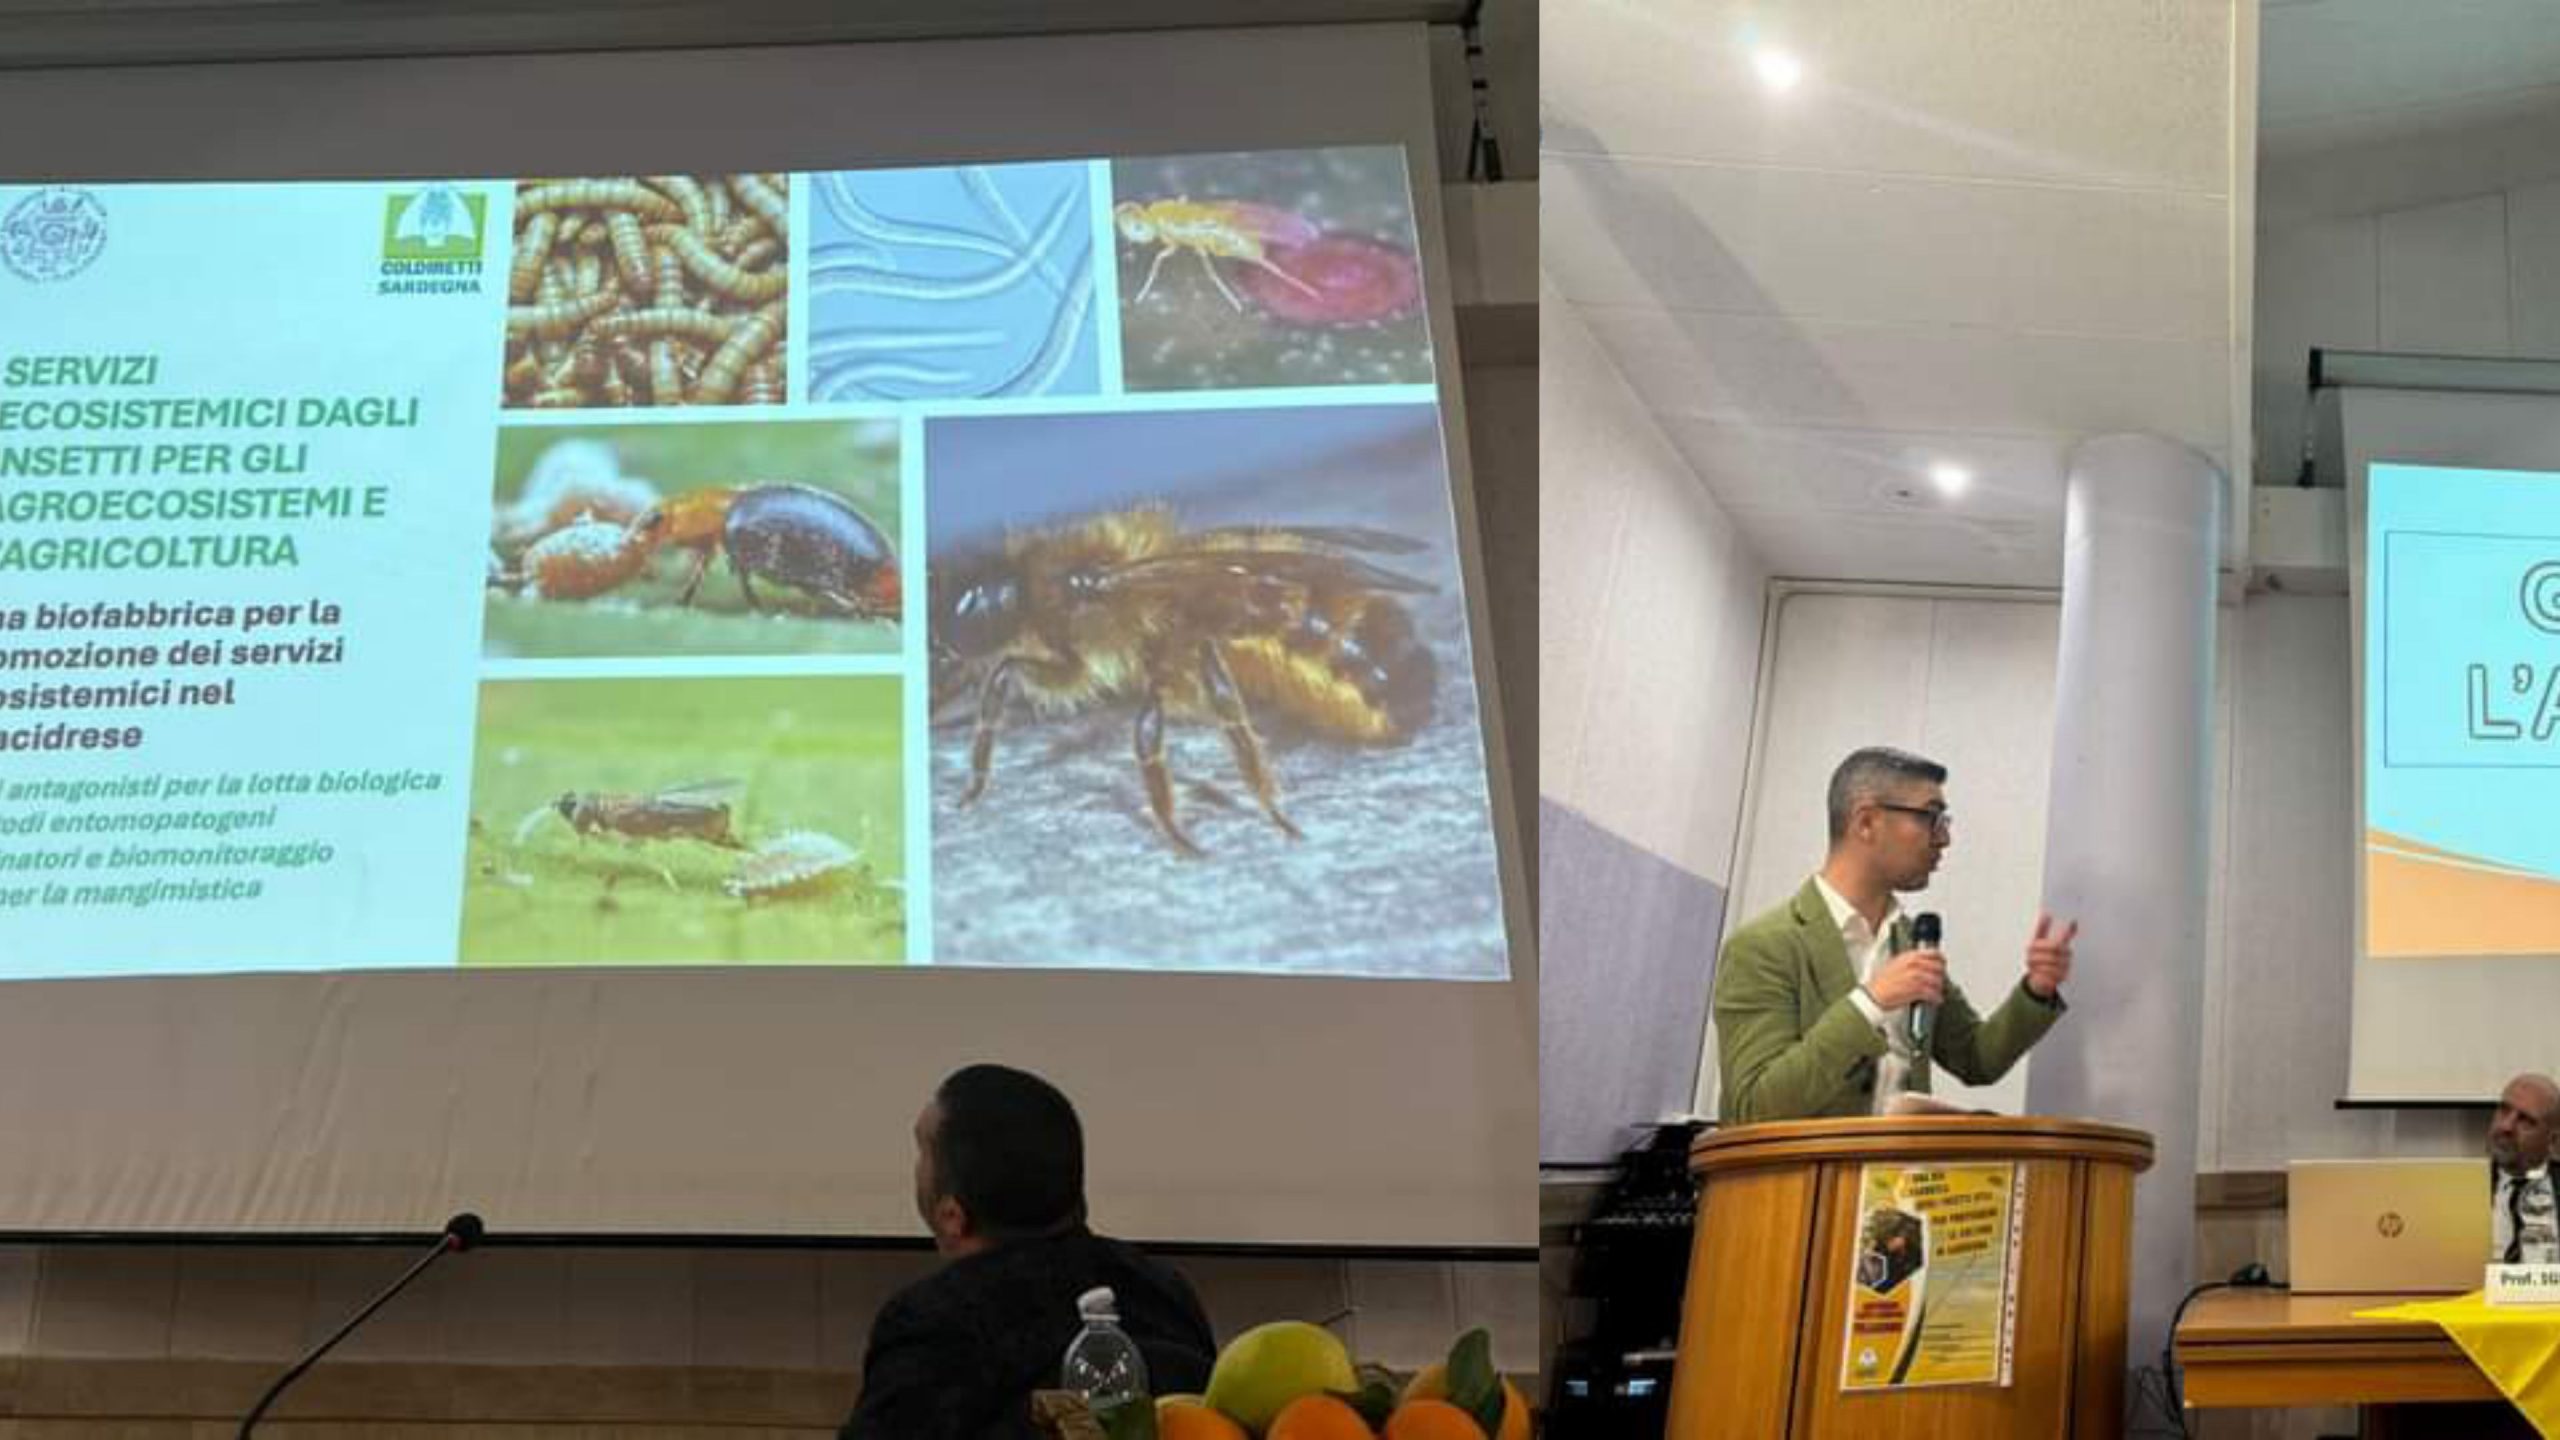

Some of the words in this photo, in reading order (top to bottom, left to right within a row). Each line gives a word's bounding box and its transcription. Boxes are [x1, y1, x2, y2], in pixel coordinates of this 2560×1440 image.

[380, 260, 483, 275] COLDIRETTI
[378, 280, 481, 295] SARDEGNA
[4, 356, 158, 387] SERVIZI
[0, 397, 287, 430] ECOSISTEMICI
[296, 396, 418, 428] DAGLI
[0, 444, 141, 477] NSETTI
[152, 444, 231, 475] PER
[242, 443, 308, 474] GLI
[0, 485, 351, 522] GROECOSISTEMI
[362, 486, 388, 518] E
[36, 600, 235, 630] biofabbrica
[242, 604, 302, 633] per
[310, 597, 341, 626] la
[167, 638, 223, 667] dei
[230, 635, 343, 666] servizi
[0, 678, 172, 710] sistemici
[178, 677, 236, 706] nel
[8, 774, 161, 802] antagonisti
[161, 777, 213, 801] per
[215, 773, 243, 796] la
[246, 771, 312, 794] lotta
[316, 768, 442, 796] biologica
[51, 804, 277, 835] entomopatogeni
[85, 852, 103, 869] e
[108, 839, 335, 869] biomonitoraggio
[43, 880, 69, 906] la
[73, 877, 263, 907] mangimistica
